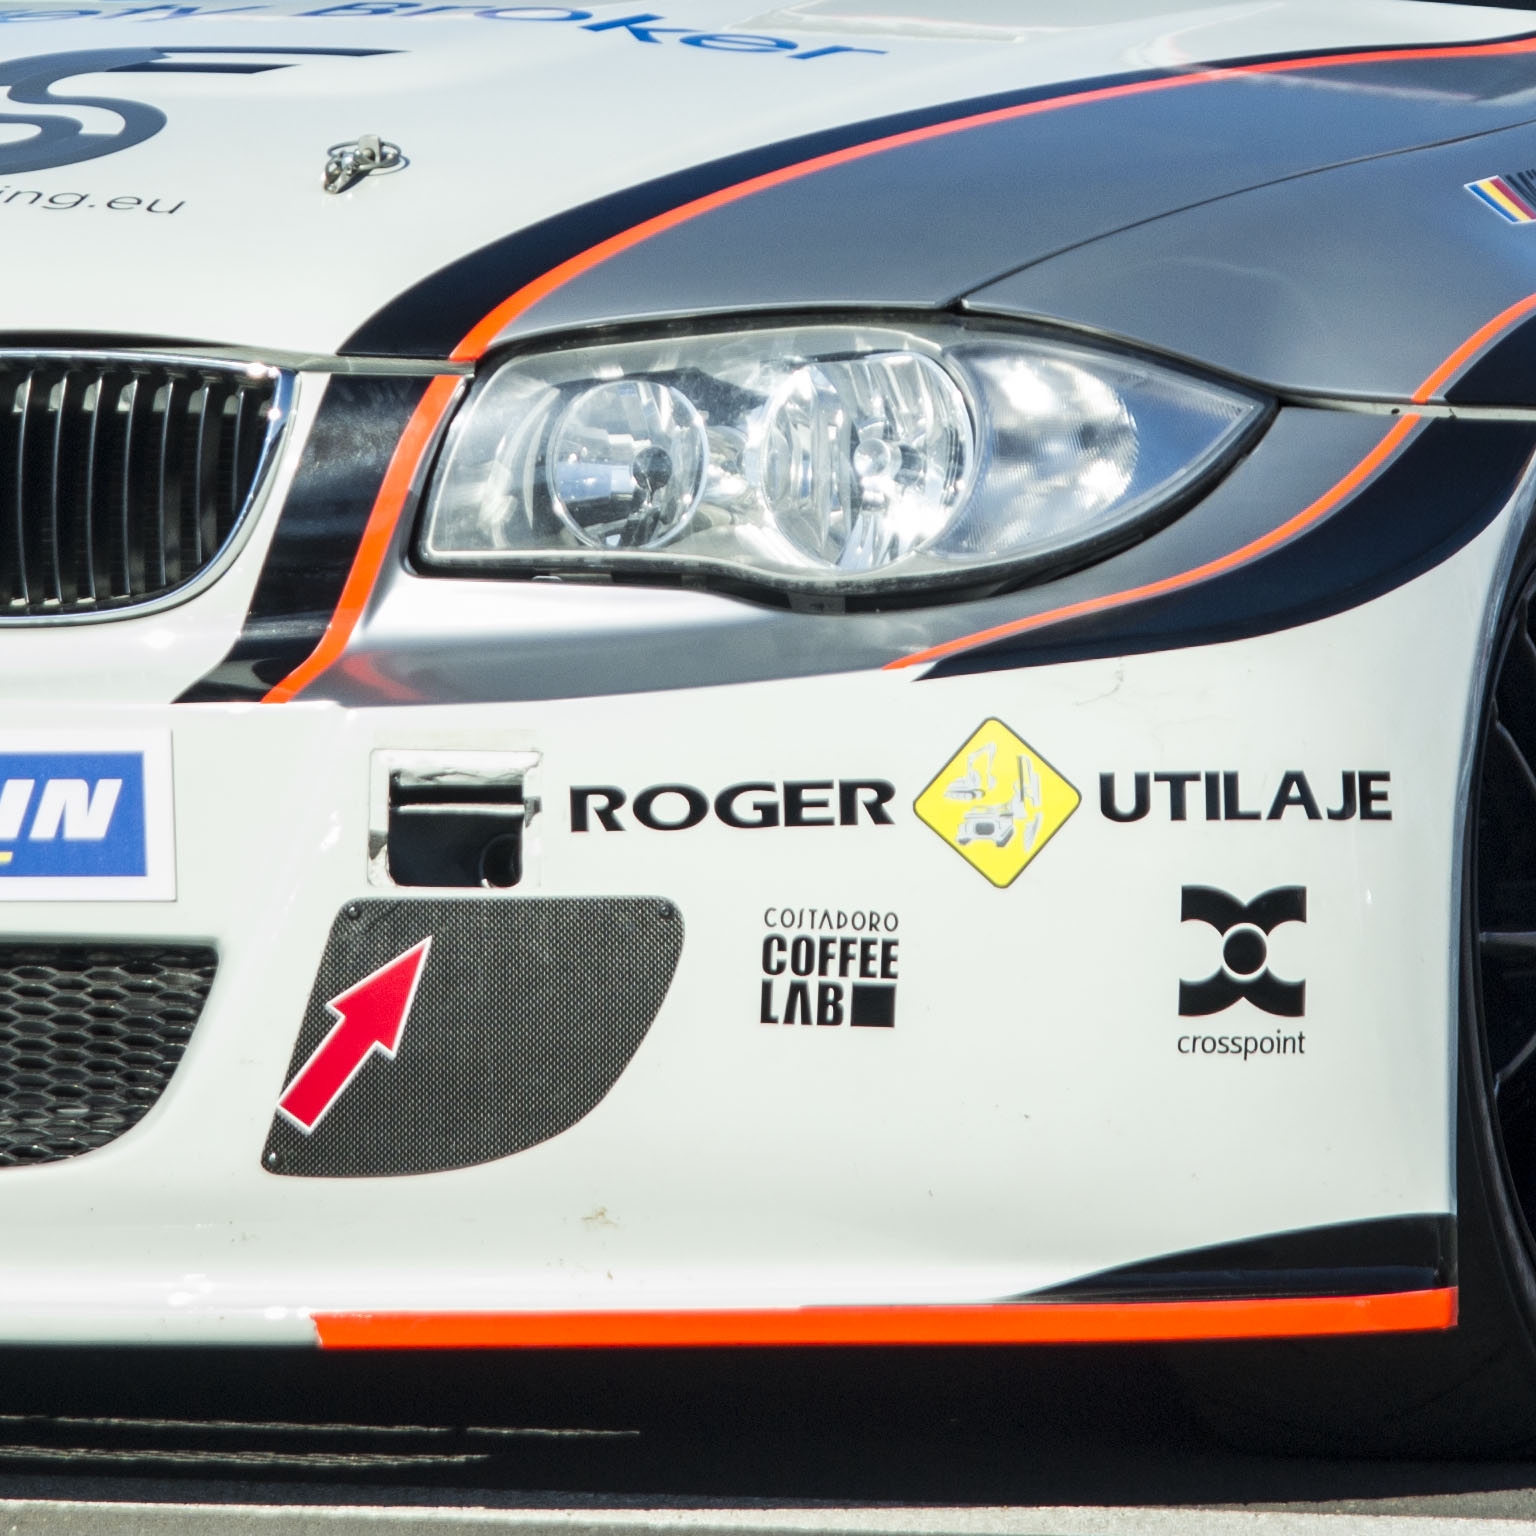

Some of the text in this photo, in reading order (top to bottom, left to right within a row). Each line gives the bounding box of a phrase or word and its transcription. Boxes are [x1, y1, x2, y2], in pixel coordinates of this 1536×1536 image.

[292, 1, 888, 61] Broker
[570, 769, 1394, 833] ROGER UTILAJE
[763, 907, 900, 933] COSTADORO
[761, 936, 899, 980] COFFEE
[760, 979, 844, 1027] LAB
[1177, 1028, 1306, 1061] crosspoint
